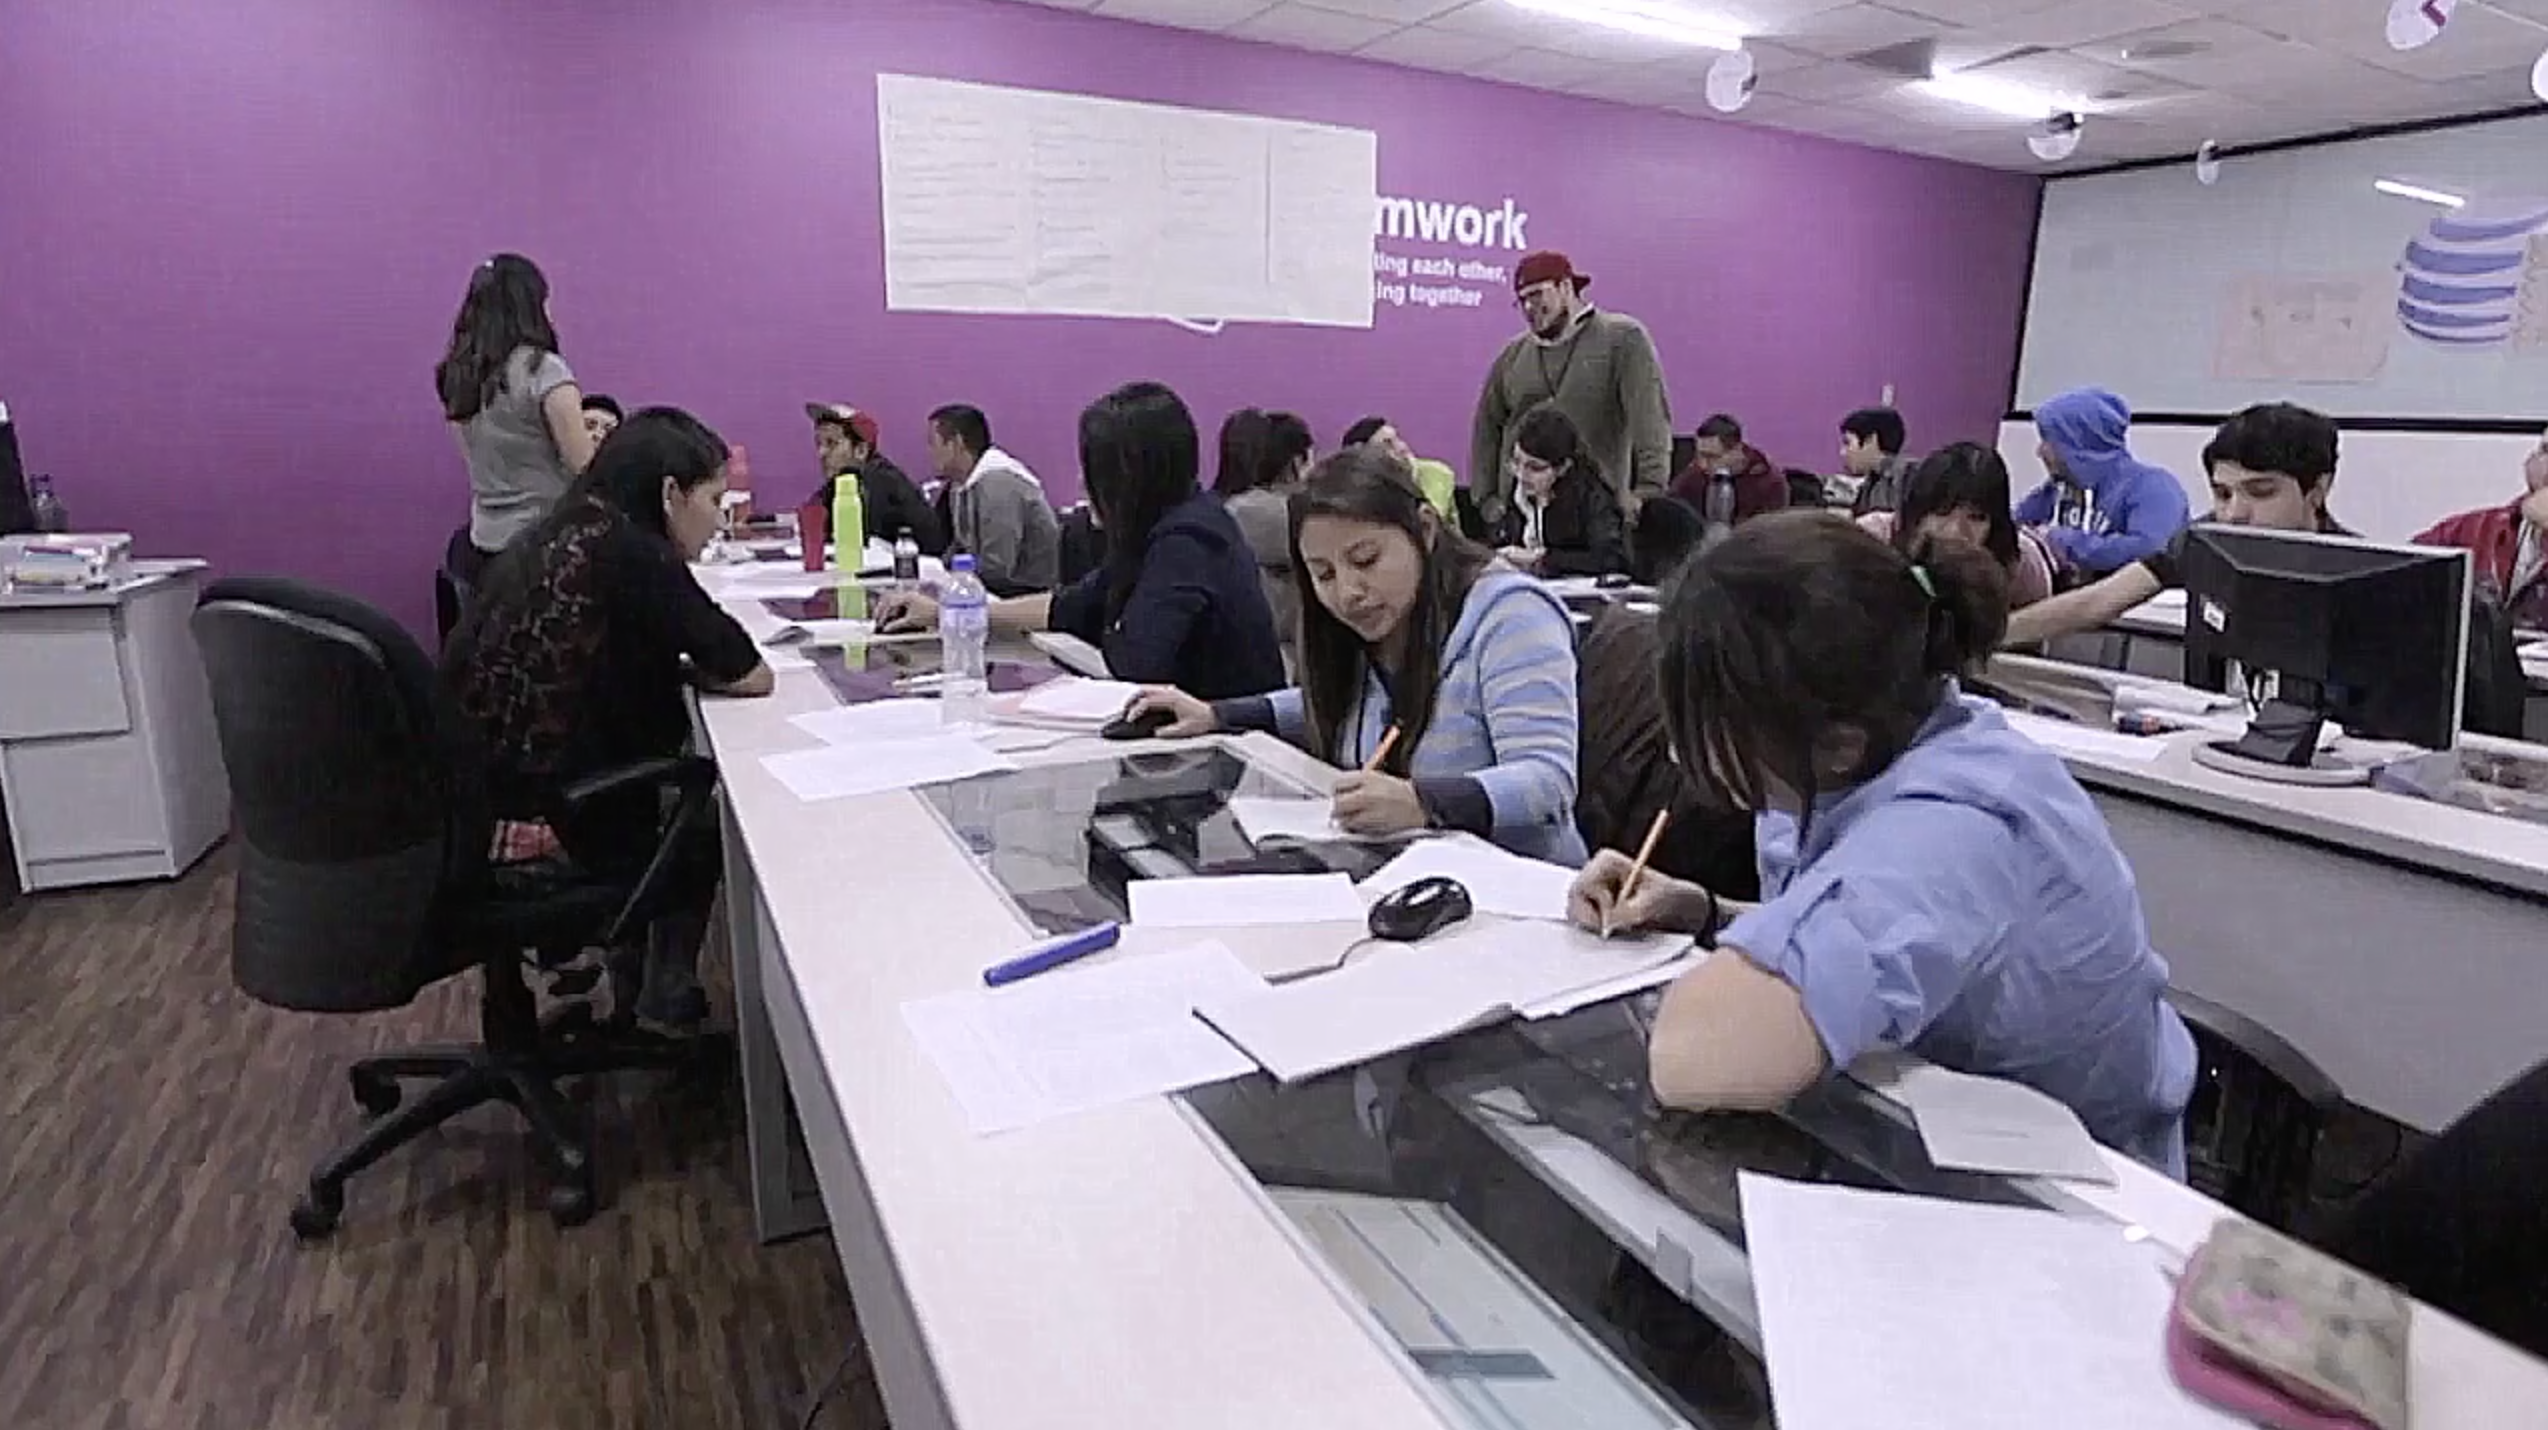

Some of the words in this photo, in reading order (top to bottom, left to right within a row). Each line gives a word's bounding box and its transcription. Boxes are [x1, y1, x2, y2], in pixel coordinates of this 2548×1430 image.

[1375, 196, 1528, 250] mwork
[1411, 258, 1455, 276] each
[1409, 283, 1483, 306] together
